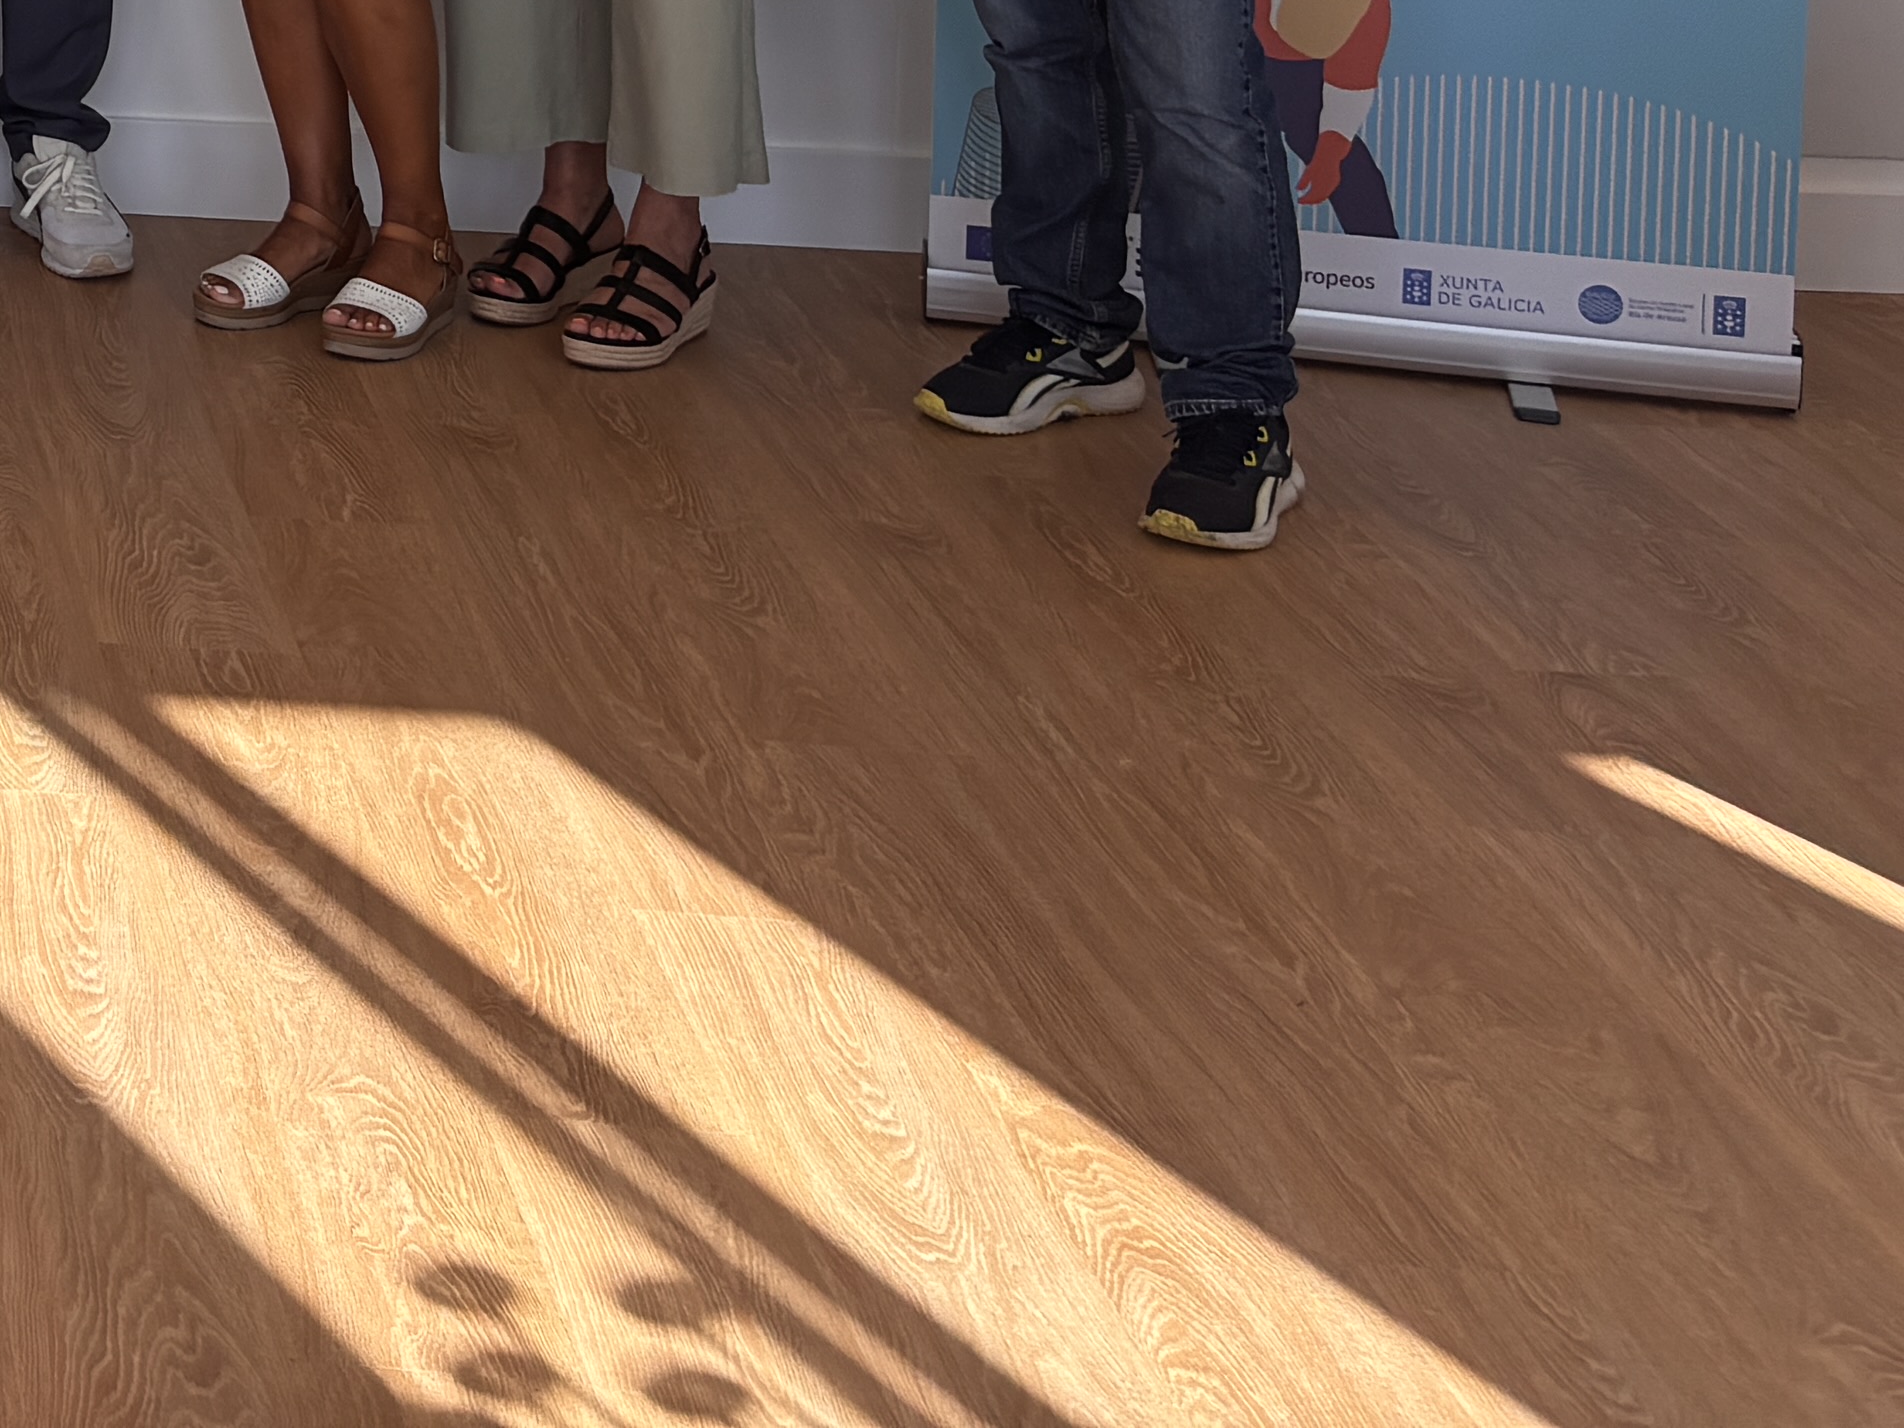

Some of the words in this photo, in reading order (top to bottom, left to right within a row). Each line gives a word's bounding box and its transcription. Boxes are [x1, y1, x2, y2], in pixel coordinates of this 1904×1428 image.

[1440, 274, 1504, 293] XUNTA
[1438, 292, 1462, 307] DE
[1469, 295, 1545, 314] GALICIA
